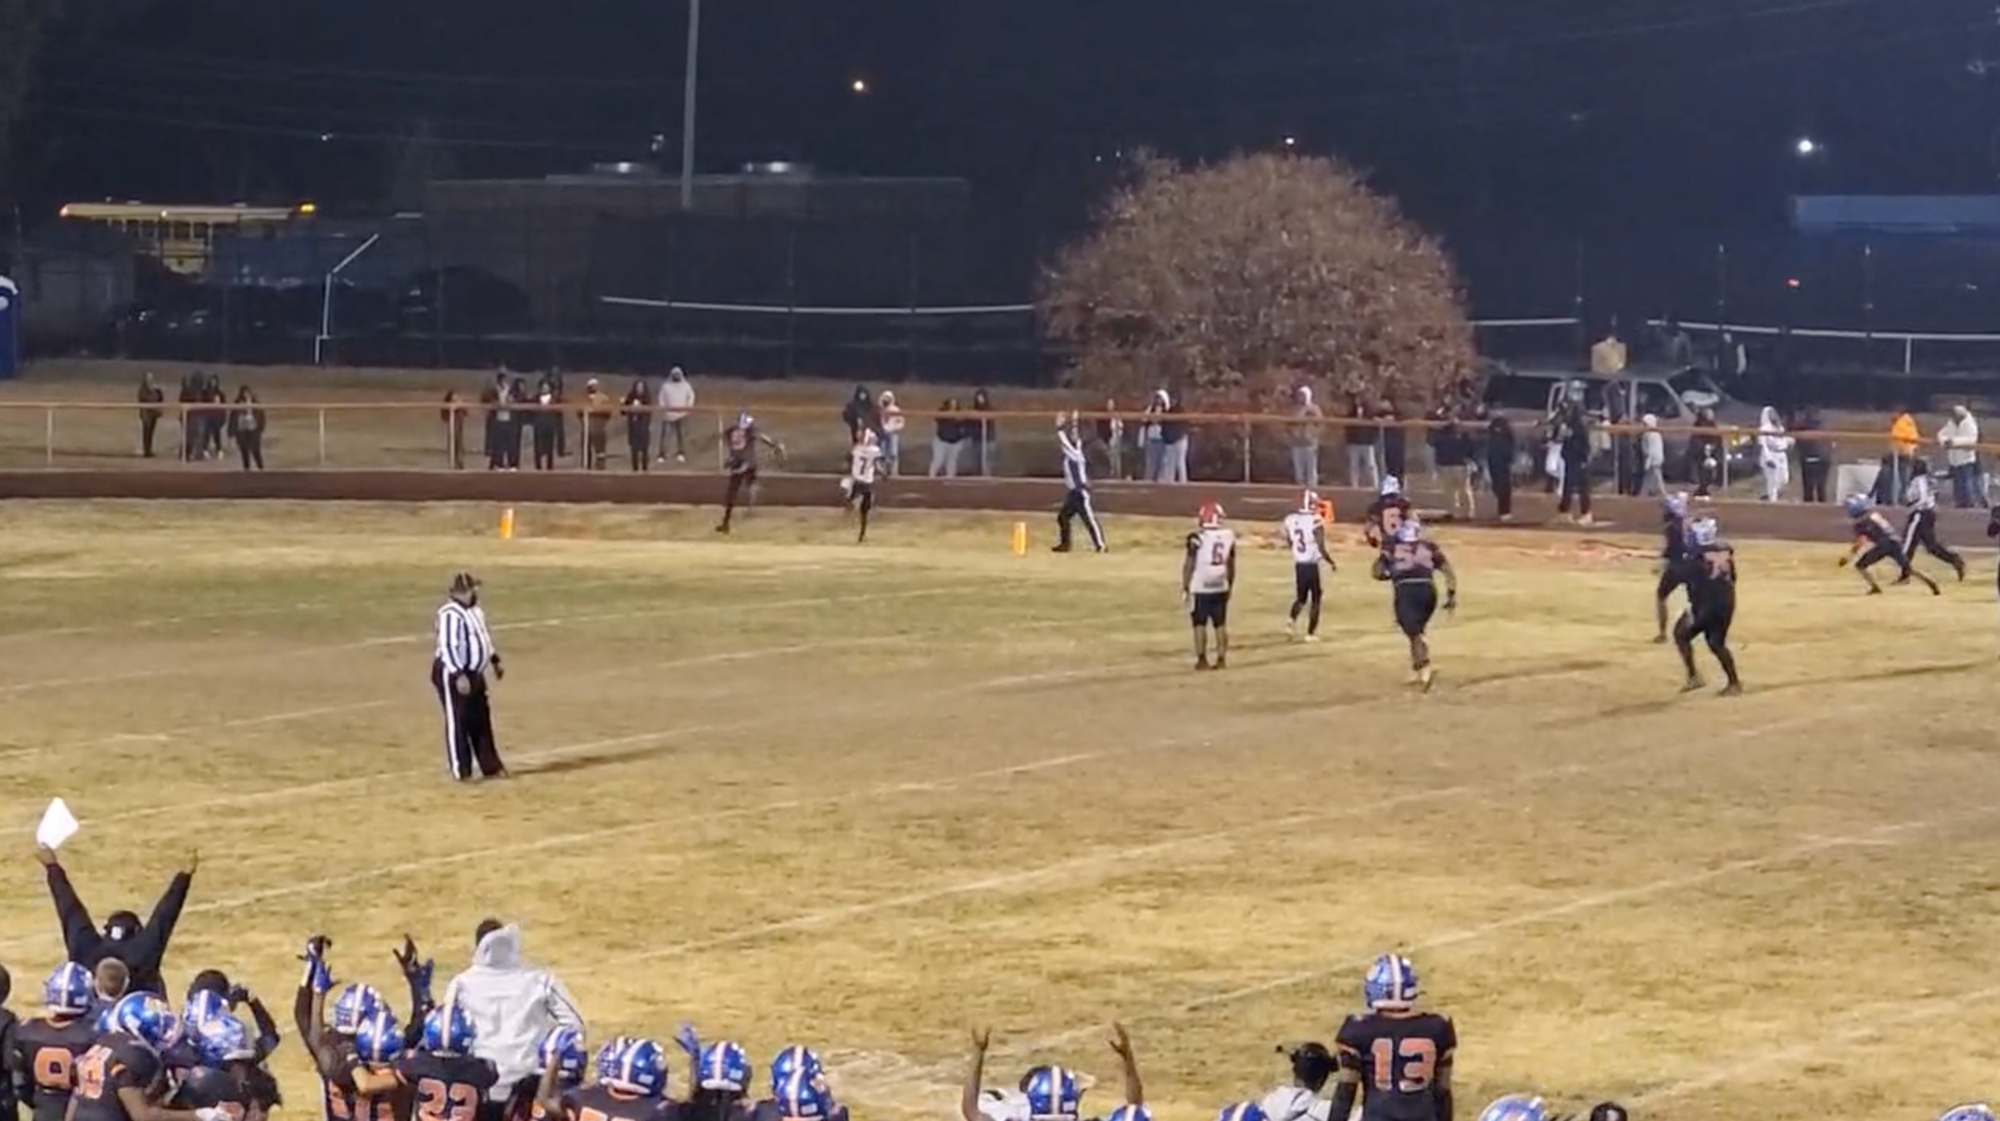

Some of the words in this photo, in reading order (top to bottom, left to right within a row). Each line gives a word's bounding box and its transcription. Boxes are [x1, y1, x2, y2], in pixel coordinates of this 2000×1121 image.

[1211, 541, 1225, 566] 6
[1295, 528, 1307, 554] 3
[1371, 1038, 1437, 1092] 13
